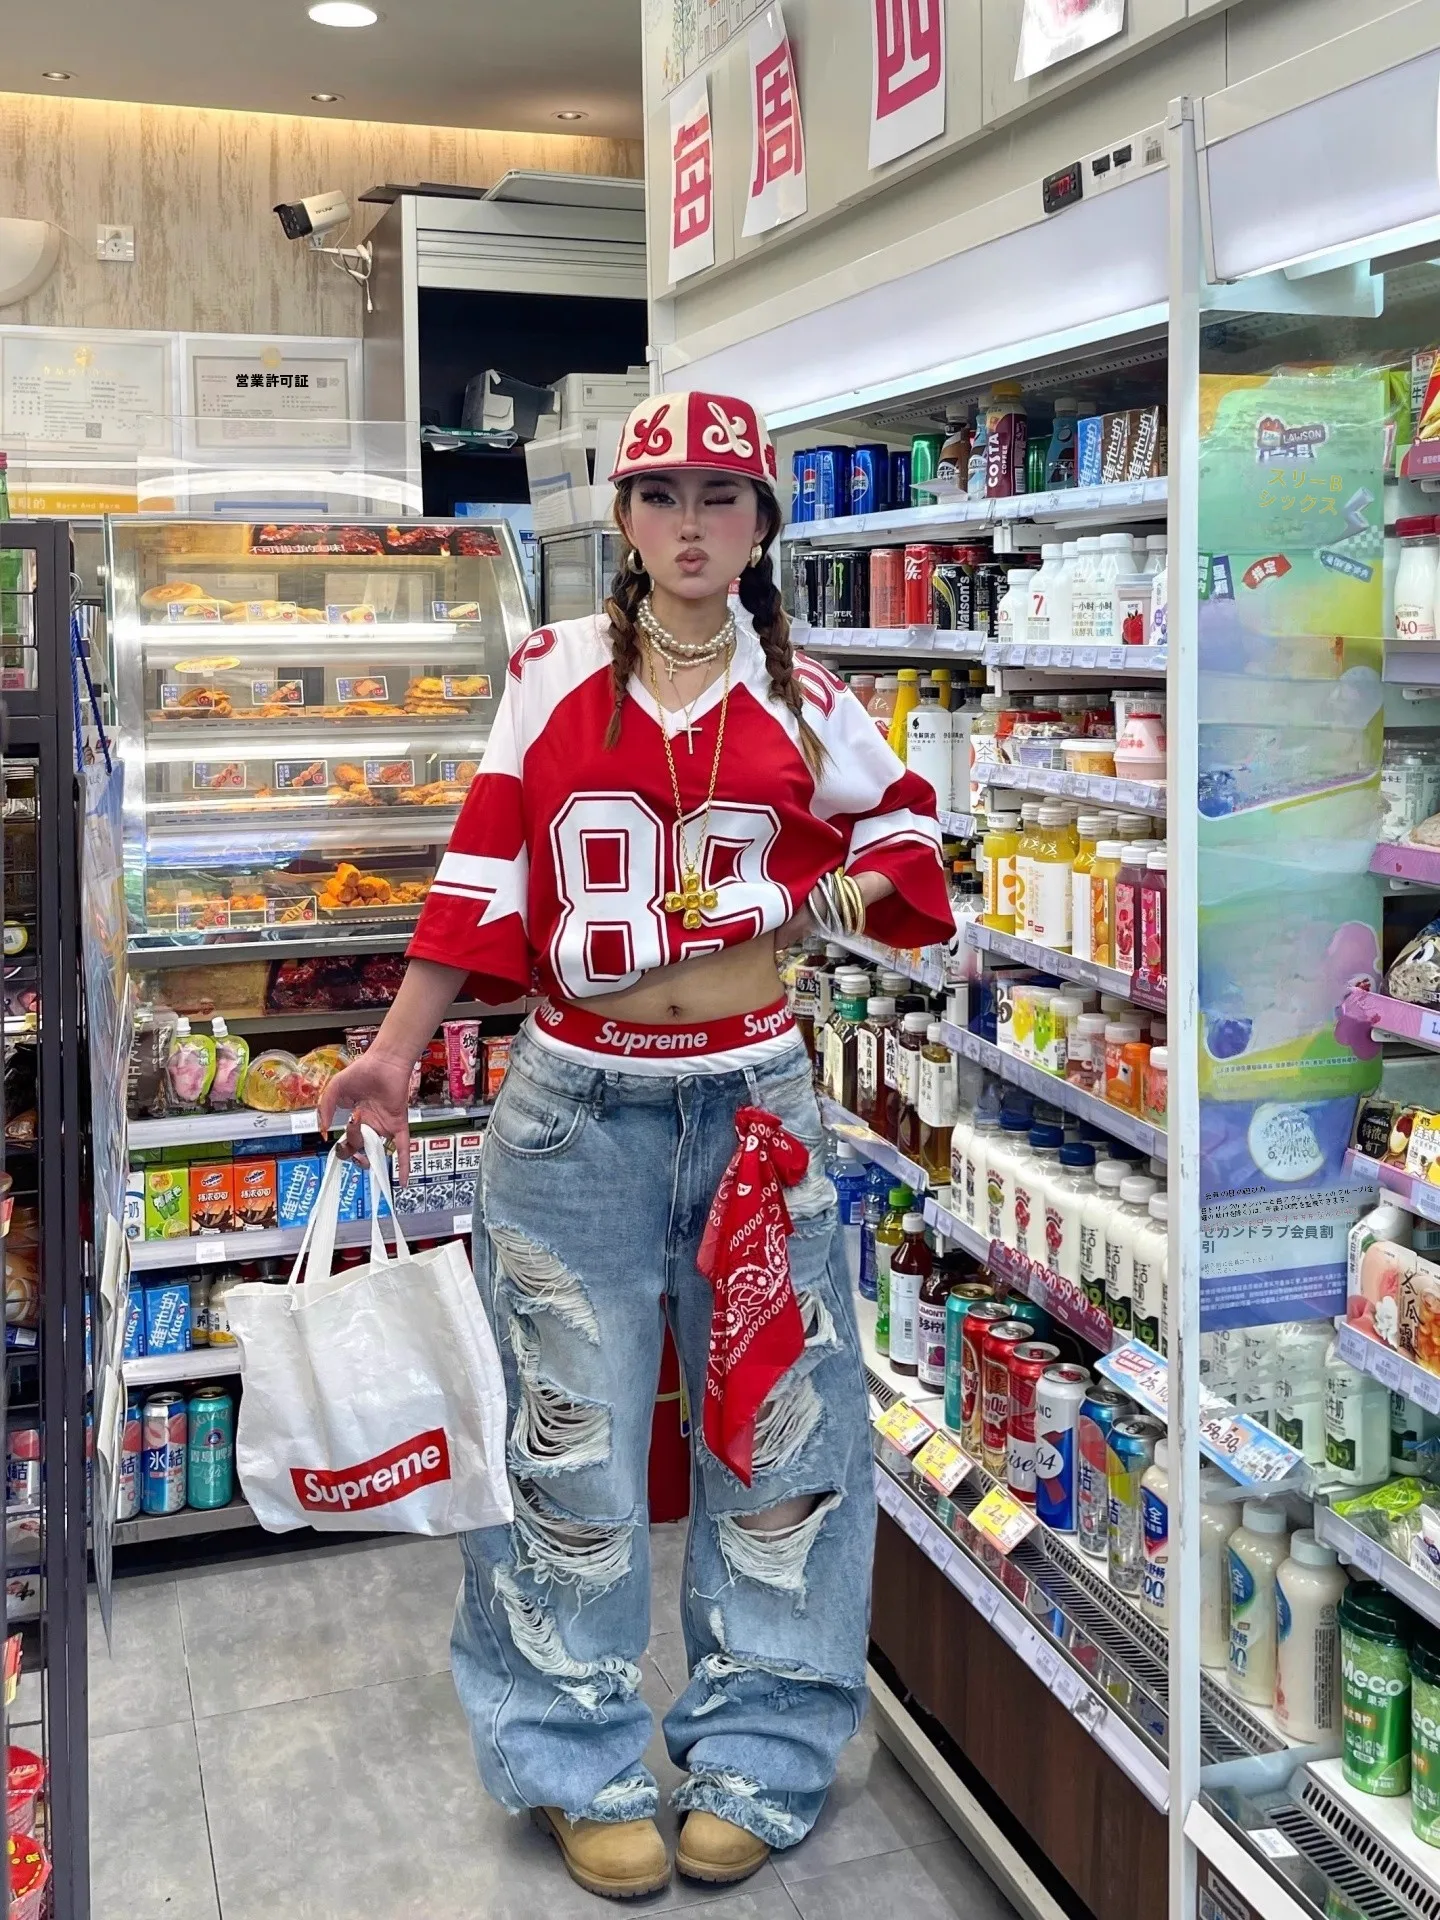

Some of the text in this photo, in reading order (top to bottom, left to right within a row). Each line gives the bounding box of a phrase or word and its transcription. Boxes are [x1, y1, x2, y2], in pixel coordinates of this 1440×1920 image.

[751, 38, 803, 197] 周
[235, 374, 309, 388] 営業許可証
[1283, 429, 1322, 443] LAWSON
[988, 433, 1001, 488] COSTA
[1259, 490, 1338, 515] シックス
[957, 575, 970, 631] Watson's
[976, 740, 994, 762] 茶
[594, 1021, 709, 1055] Supreme
[428, 1159, 453, 1171] 牛乳茶
[280, 1164, 310, 1220] 維他奶
[1202, 1240, 1215, 1253] 引
[149, 1292, 180, 1348] 維他奶
[305, 1442, 441, 1510] Supreme
